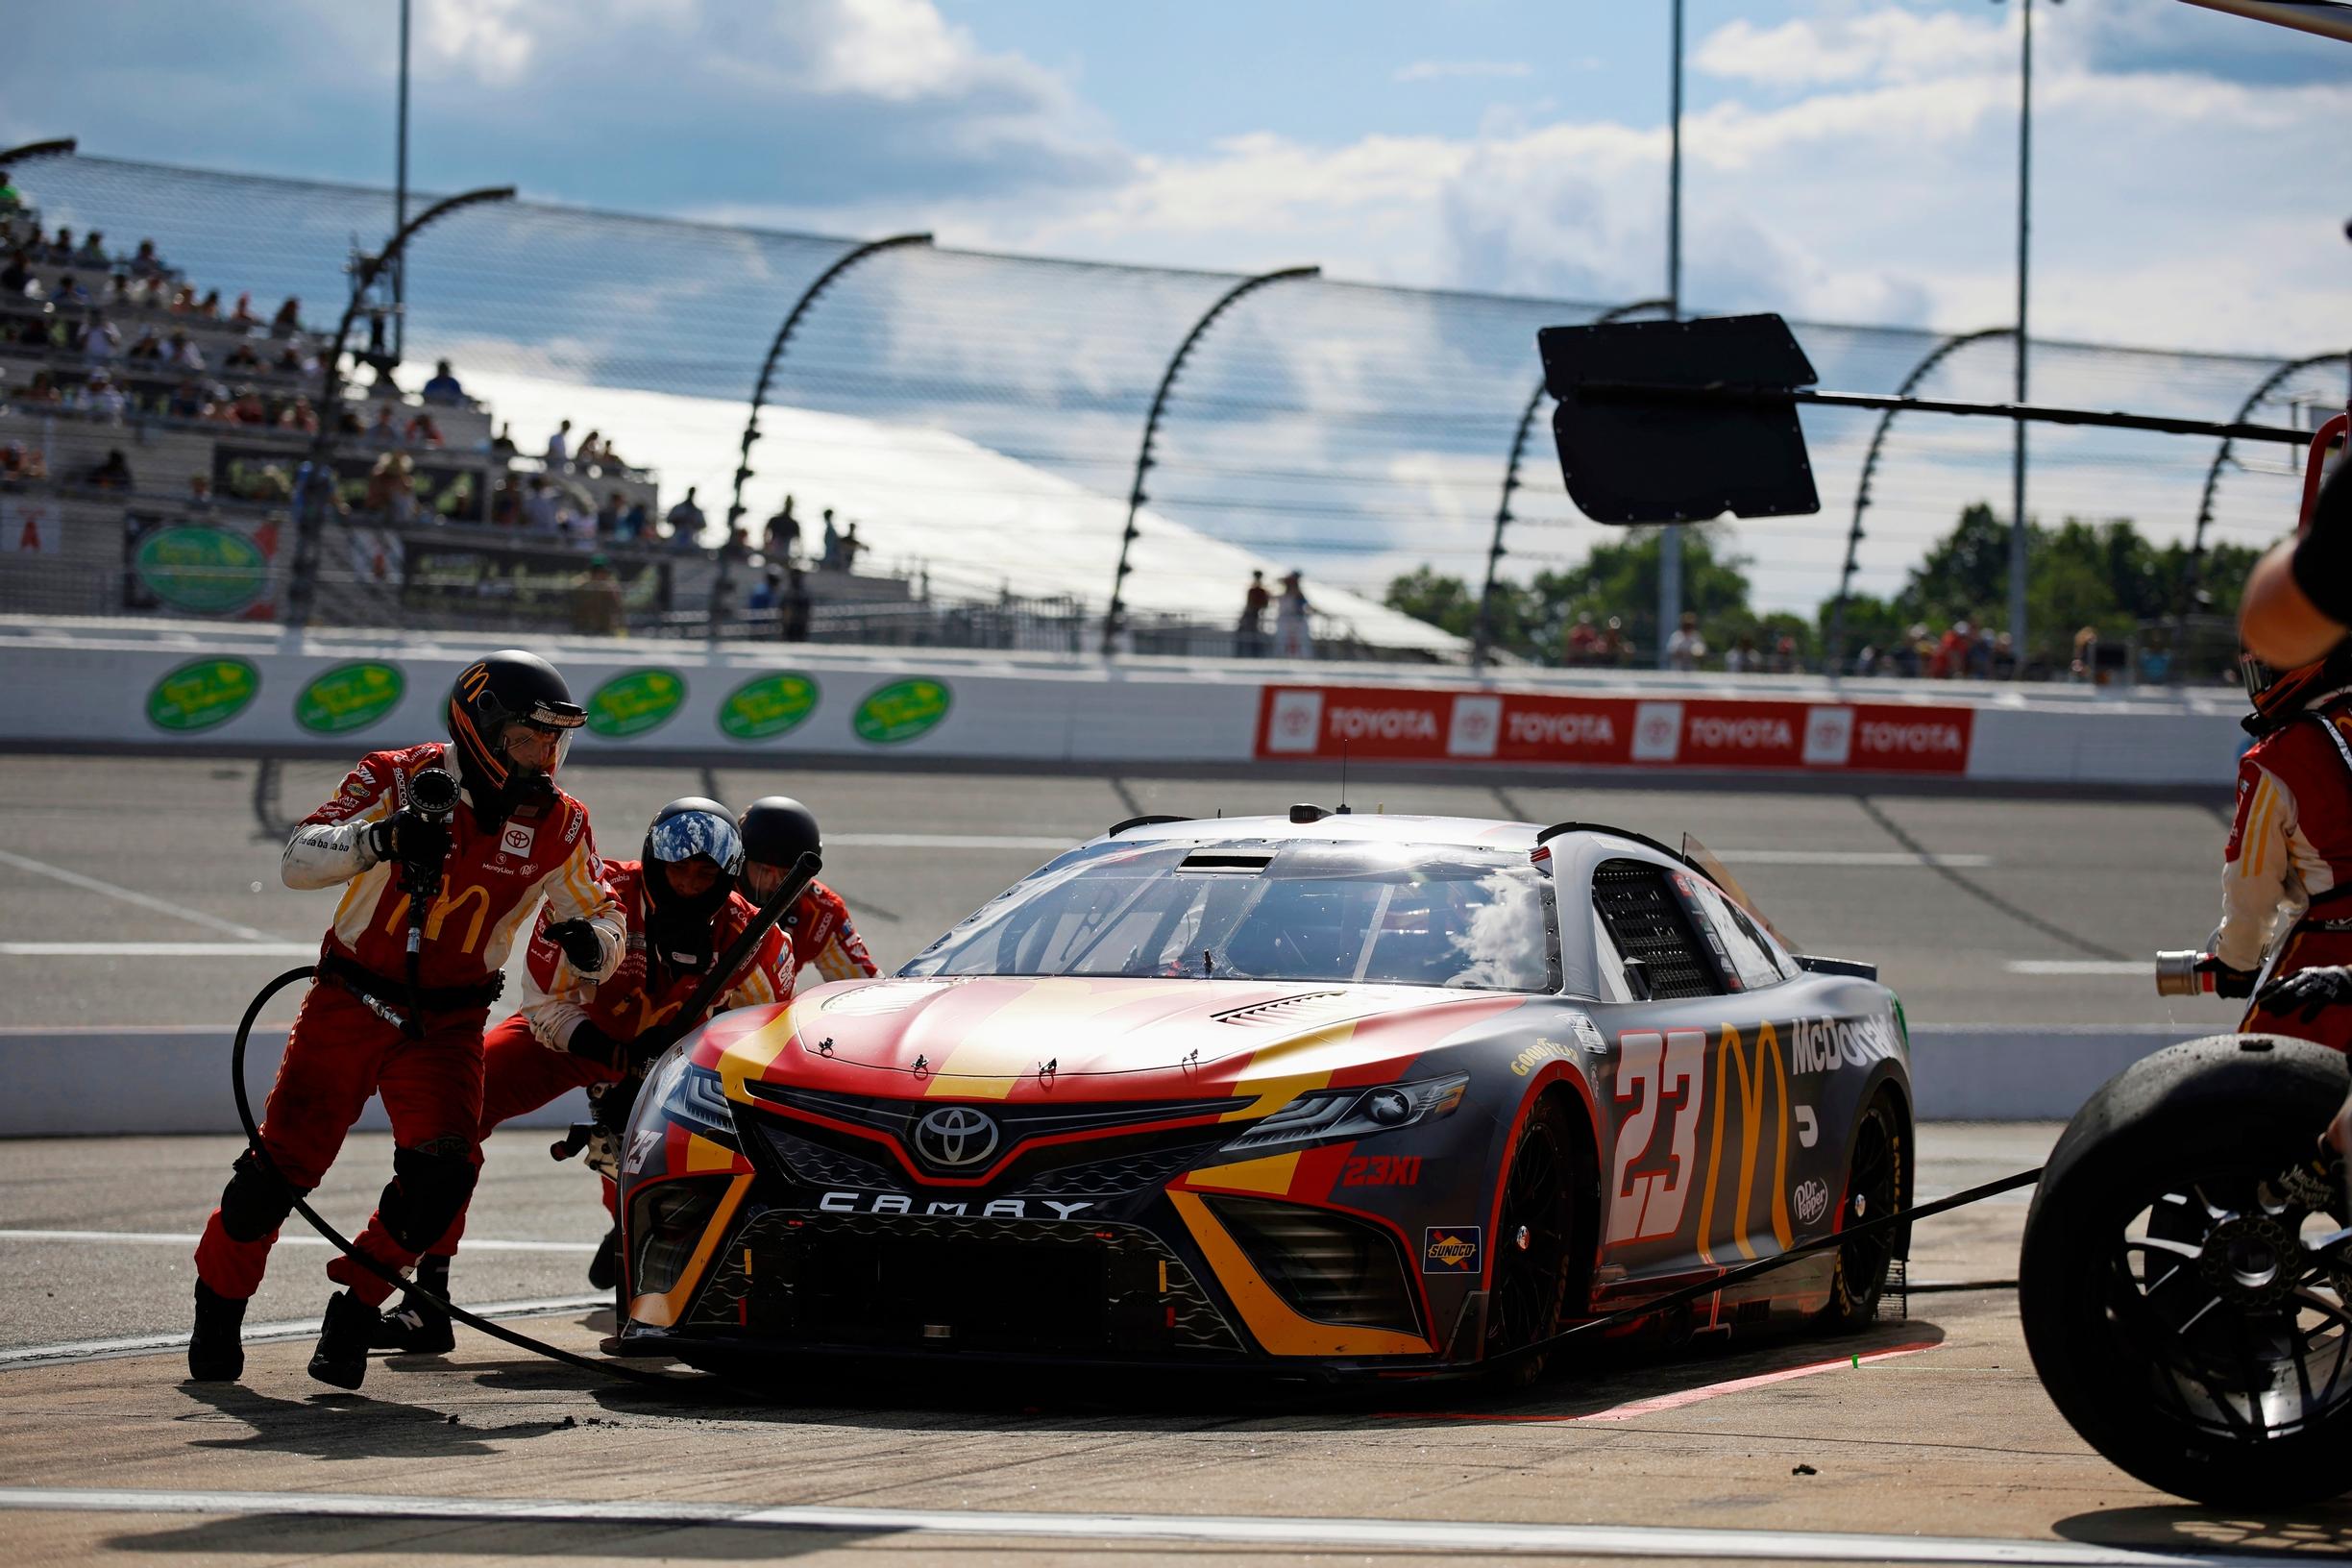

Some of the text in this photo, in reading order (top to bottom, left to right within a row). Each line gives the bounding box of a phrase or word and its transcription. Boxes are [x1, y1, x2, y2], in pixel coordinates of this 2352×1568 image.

[1329, 707, 1963, 753] TOYOTA TOYOTA TOYOTA TOYOTA
[347, 783, 371, 797] SUNOCO
[393, 767, 408, 807] sparco
[565, 808, 584, 844] sparco
[482, 862, 514, 875] MoneyLion
[622, 1129, 663, 1174] 23
[1605, 1030, 1706, 1246] 23
[1343, 1155, 1422, 1186] 23XI
[819, 1191, 1094, 1220] CAMRY
[1794, 1185, 1825, 1220] Pepper
[1804, 1180, 1817, 1200] Dr
[1429, 1243, 1476, 1258] SUNOCO
